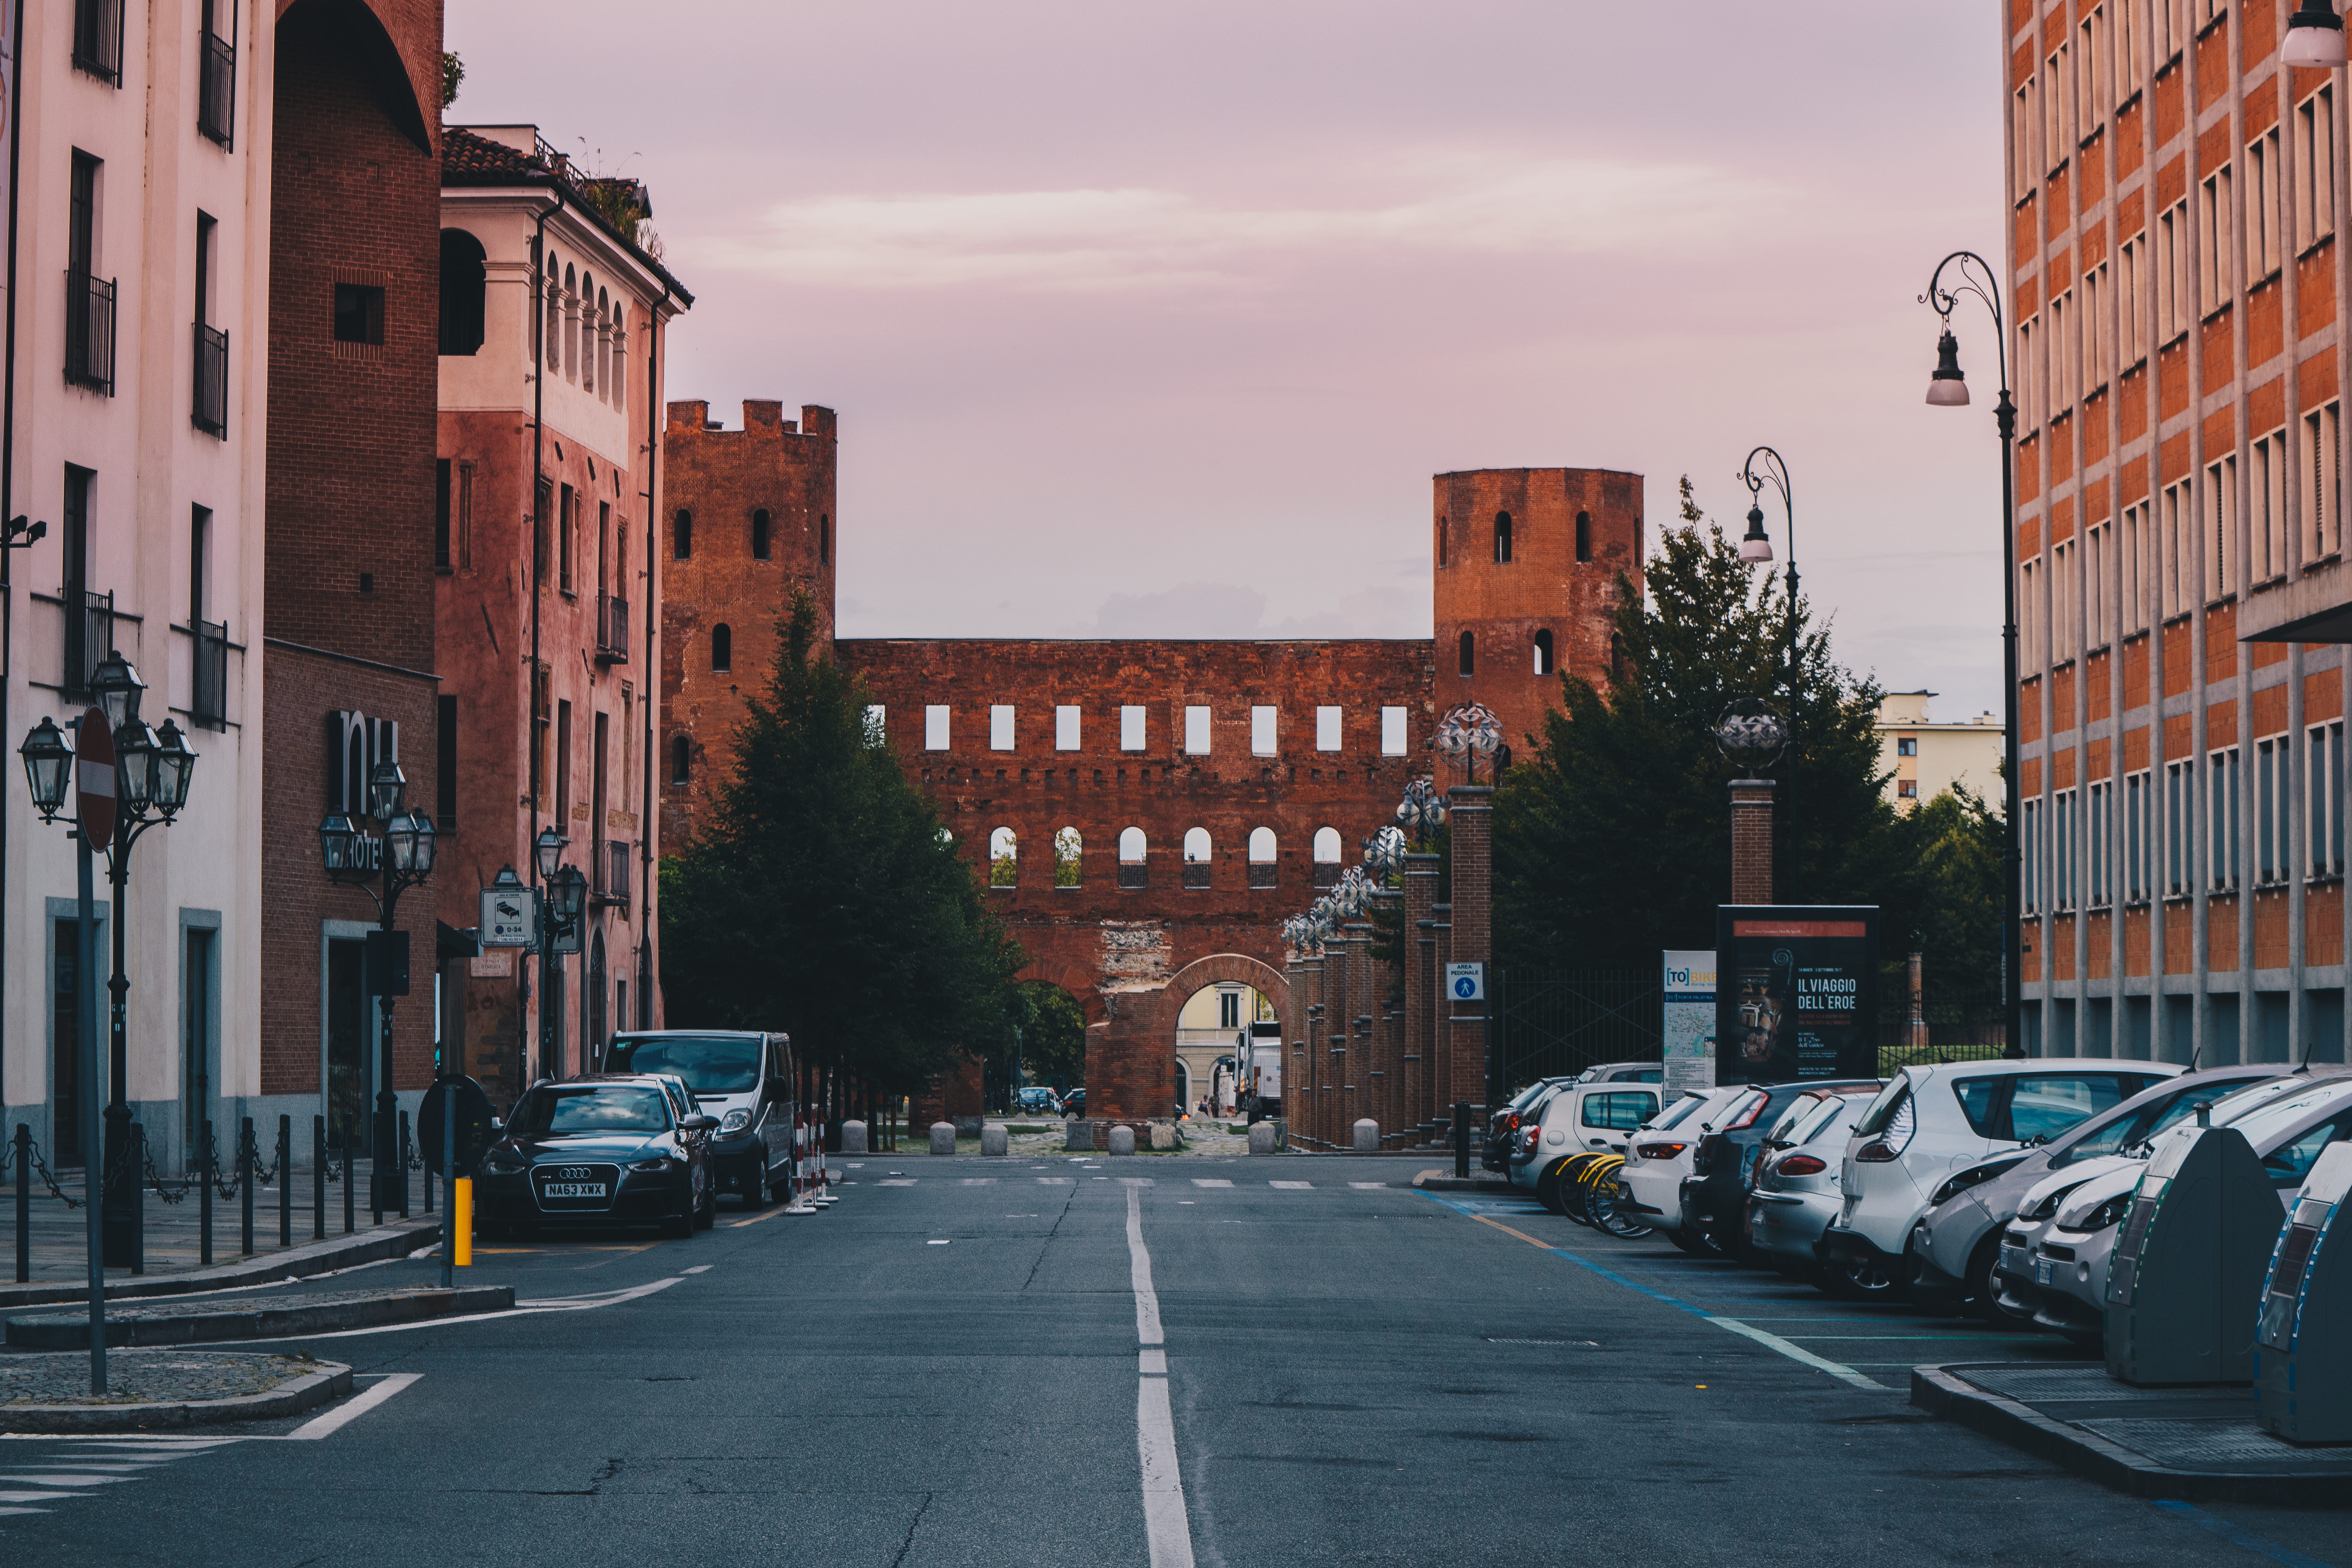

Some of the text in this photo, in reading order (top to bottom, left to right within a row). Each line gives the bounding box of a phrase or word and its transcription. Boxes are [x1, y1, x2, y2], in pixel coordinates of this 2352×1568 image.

[1798, 979, 1856, 992] IL VIAGGIO
[1798, 994, 1856, 1009] DELL'EROE
[549, 1184, 601, 1195] NA63 XWX
